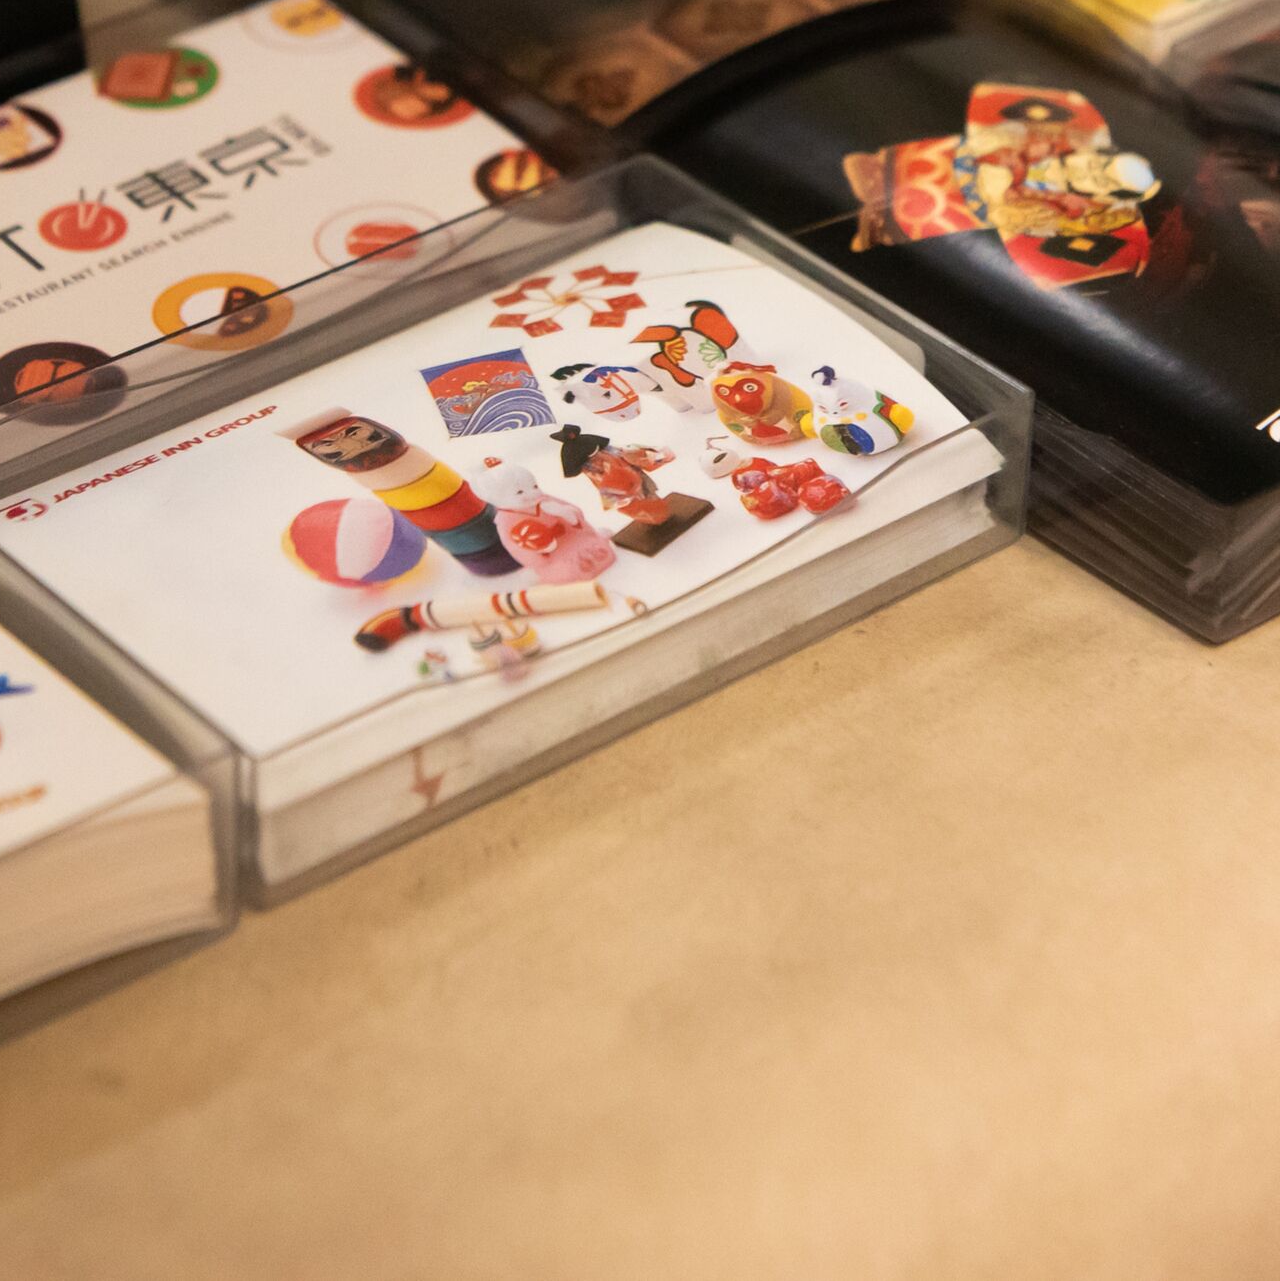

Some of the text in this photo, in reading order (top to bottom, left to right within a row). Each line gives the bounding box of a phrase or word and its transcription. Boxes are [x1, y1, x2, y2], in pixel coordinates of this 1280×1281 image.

[116, 126, 309, 222] 東京
[53, 405, 278, 503] JAPANESE INN GROUP
